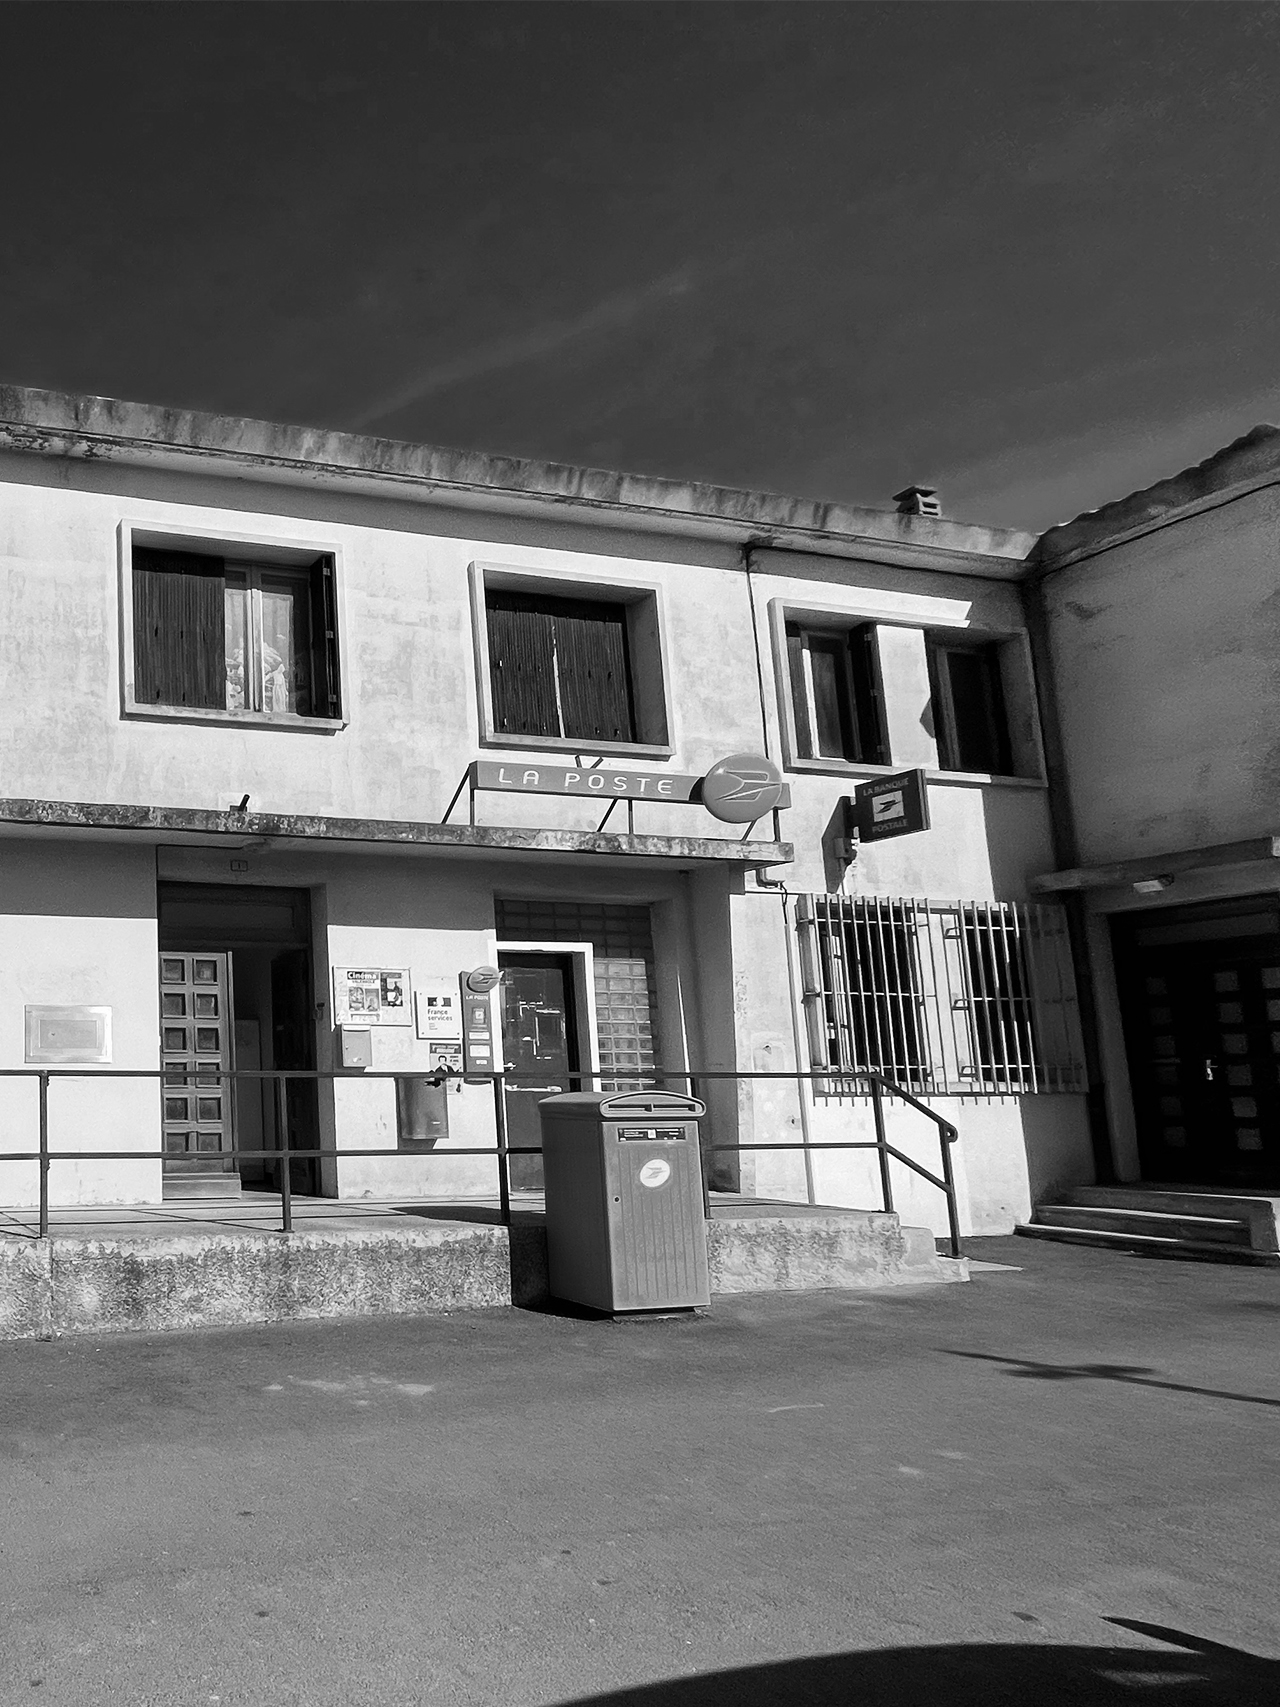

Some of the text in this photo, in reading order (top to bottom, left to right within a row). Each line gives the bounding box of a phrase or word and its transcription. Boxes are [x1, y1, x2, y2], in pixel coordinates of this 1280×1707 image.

[498, 768, 673, 794] LA POSTE
[874, 778, 909, 793] BANQUE
[872, 819, 908, 832] POSTALE
